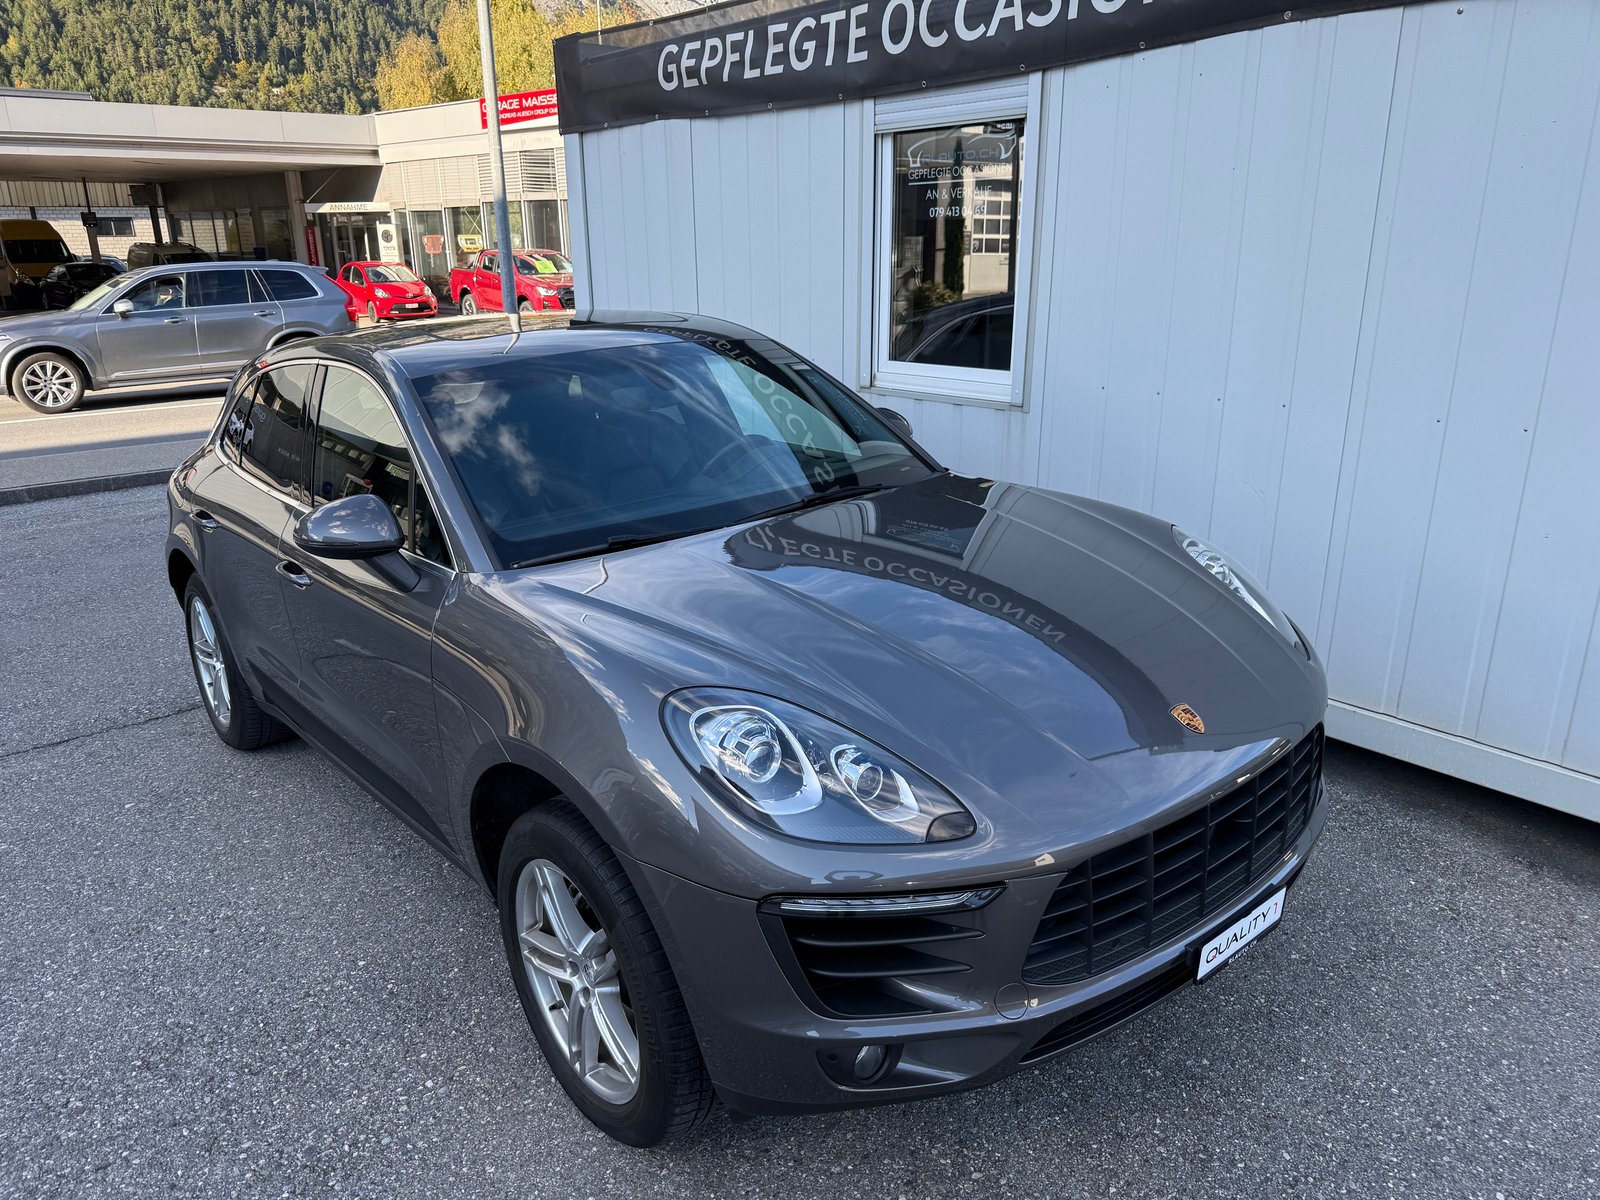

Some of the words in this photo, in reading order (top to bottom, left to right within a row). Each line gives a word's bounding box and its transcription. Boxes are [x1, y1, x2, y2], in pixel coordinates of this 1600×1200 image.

[657, 3, 869, 91] GEPFLEGTE
[482, 99, 520, 112] GRAGE
[908, 166, 951, 180] GEPFLEGTE
[952, 162, 1013, 177] OCCASIONEN
[925, 188, 939, 200] AN
[941, 189, 948, 200] &
[951, 185, 992, 199] VERKAUF
[329, 203, 369, 211] ANNAHME
[929, 207, 945, 218] 079
[946, 206, 960, 217] 413
[975, 204, 986, 216] 69
[1205, 905, 1272, 964] QUALITY
